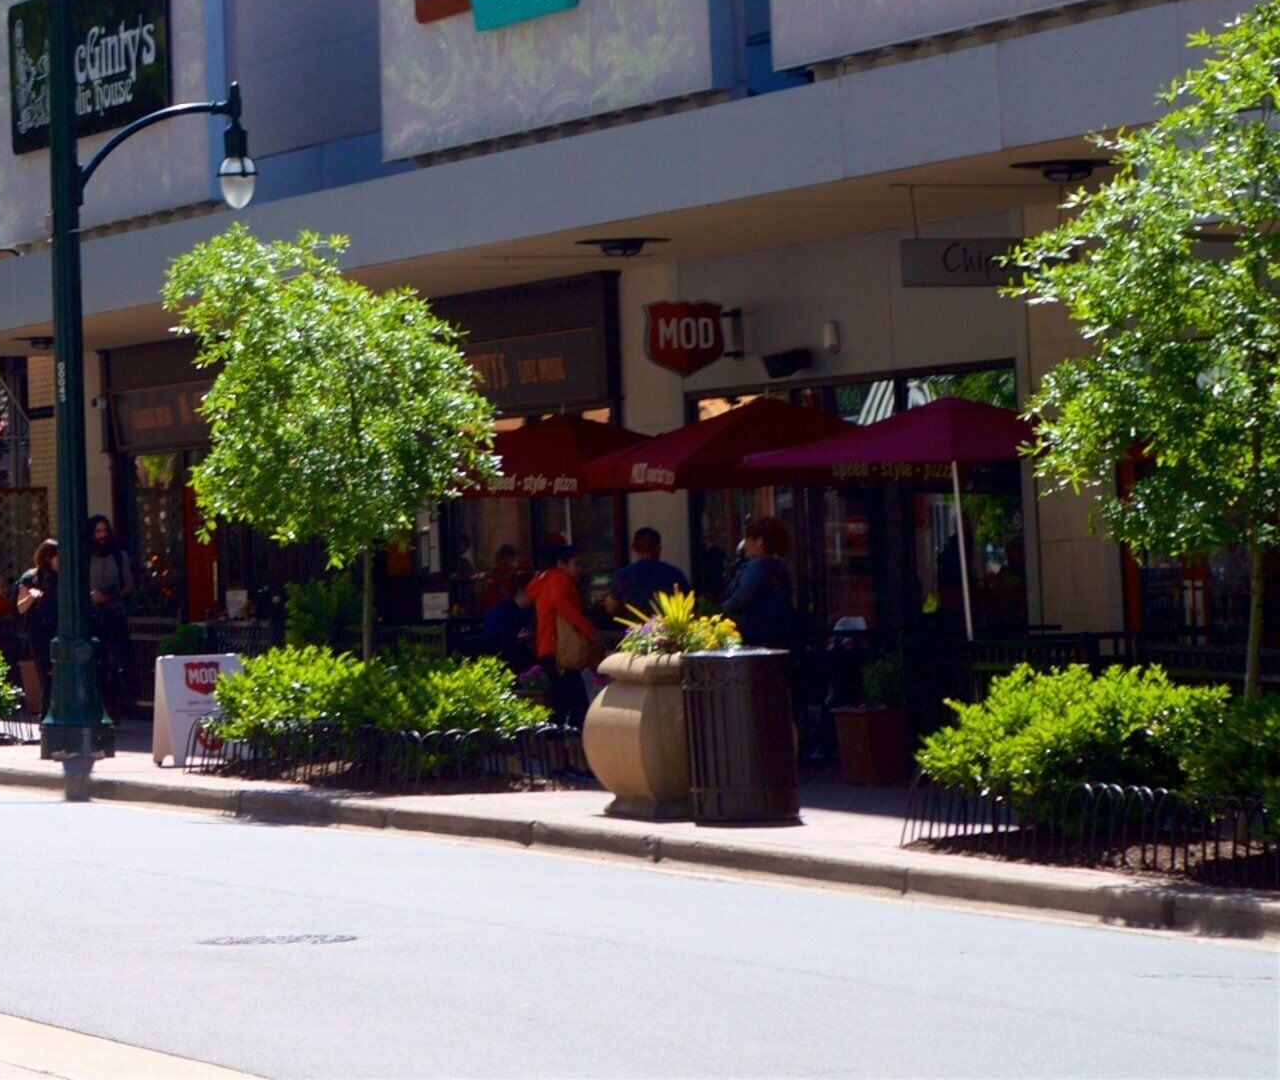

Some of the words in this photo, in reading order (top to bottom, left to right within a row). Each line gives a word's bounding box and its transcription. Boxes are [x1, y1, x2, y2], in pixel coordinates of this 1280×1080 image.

[74, 14, 157, 85] cGinty's
[93, 80, 134, 116] house
[658, 317, 715, 350] MOD
[523, 473, 547, 494] style
[552, 474, 578, 495] pizza
